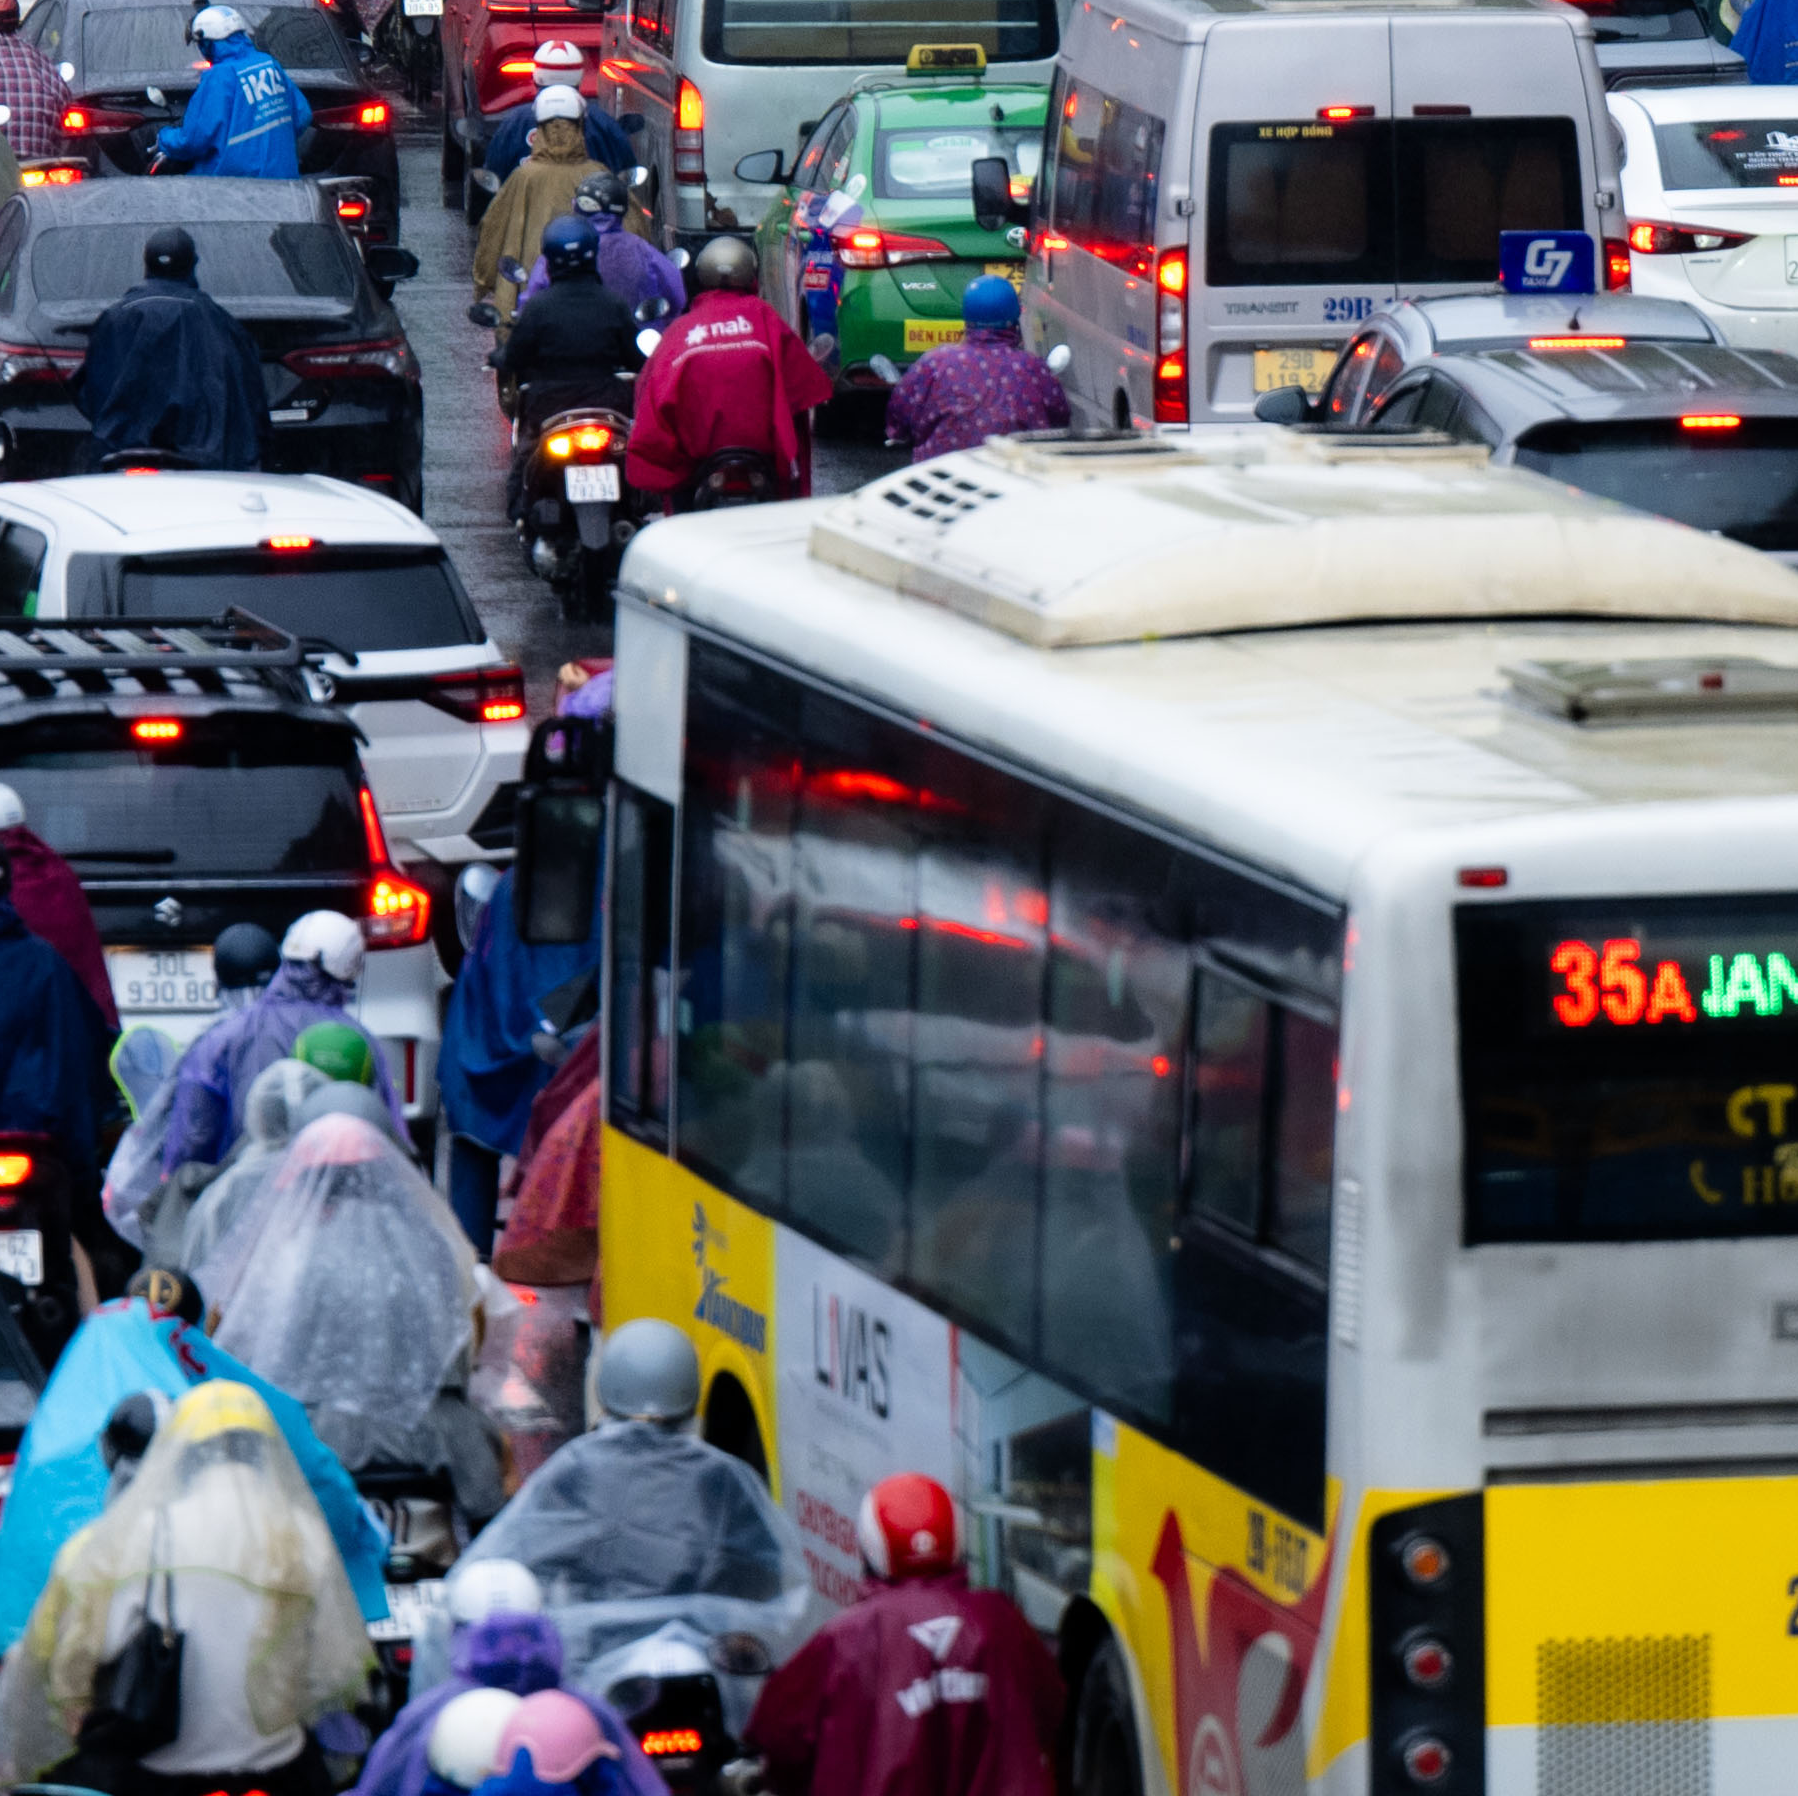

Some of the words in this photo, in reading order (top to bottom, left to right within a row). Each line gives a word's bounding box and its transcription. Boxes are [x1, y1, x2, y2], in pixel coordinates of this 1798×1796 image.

[1524, 239, 1574, 288] G7
[902, 282, 937, 290] VIOS
[1224, 301, 1299, 314] TRANSIT
[710, 315, 754, 337] nab
[1551, 938, 1696, 1026] 35A
[1727, 1085, 1795, 1140] CT
